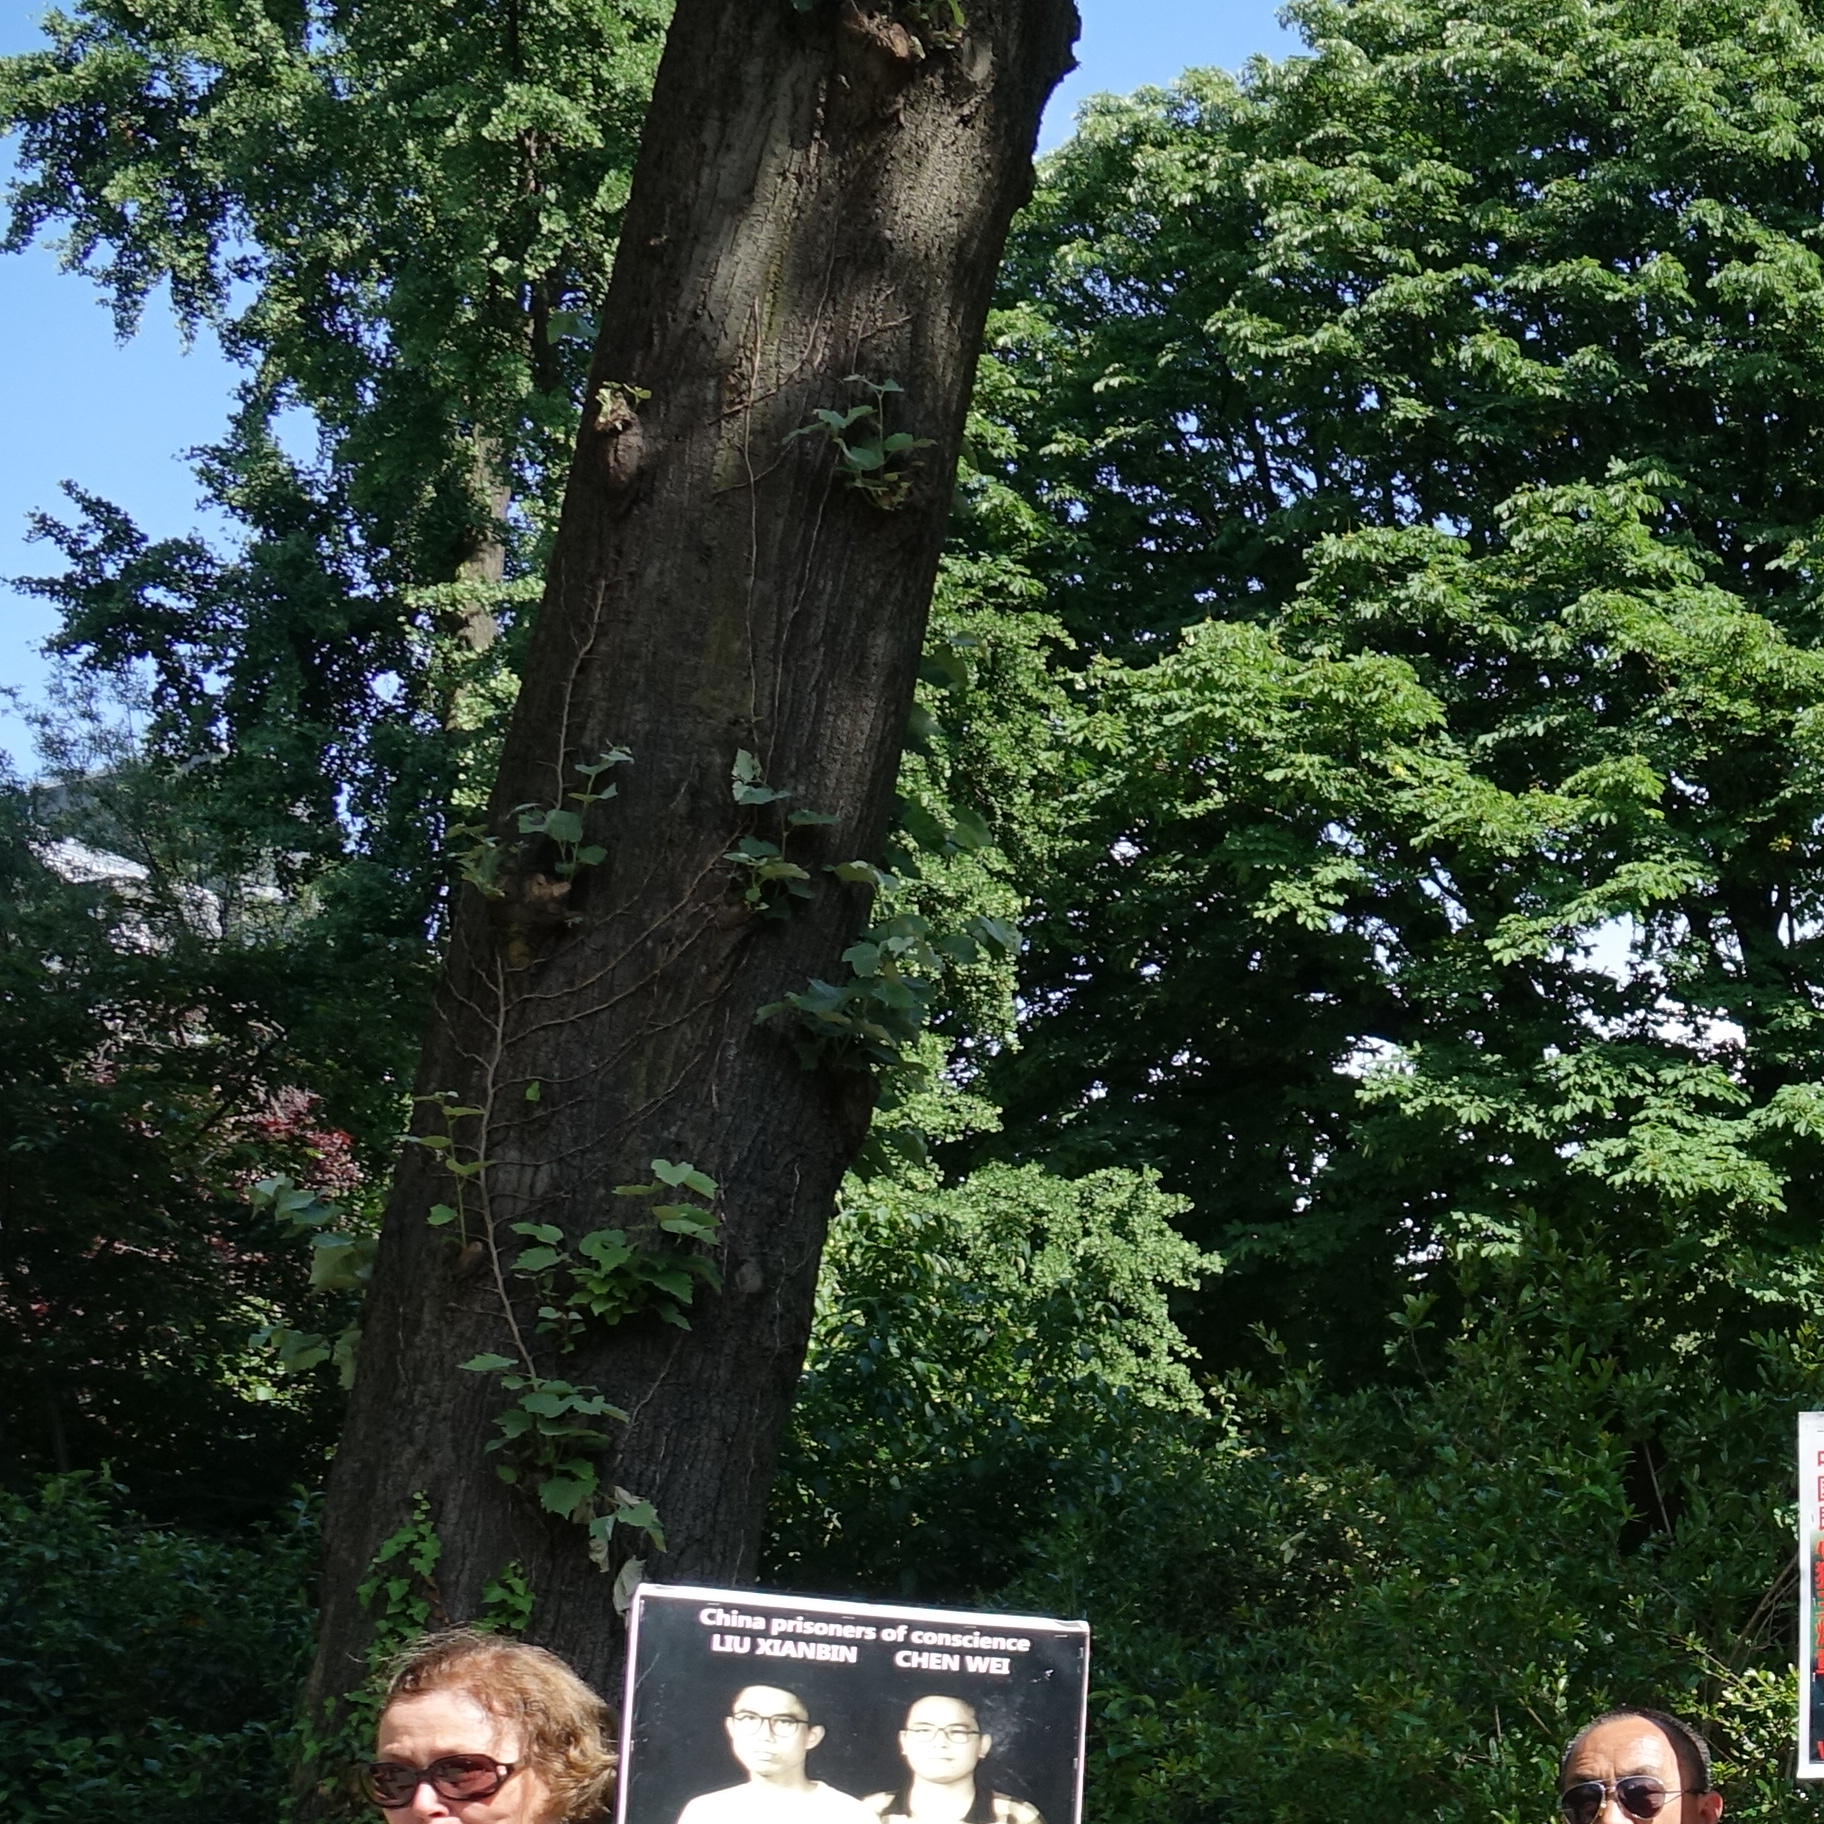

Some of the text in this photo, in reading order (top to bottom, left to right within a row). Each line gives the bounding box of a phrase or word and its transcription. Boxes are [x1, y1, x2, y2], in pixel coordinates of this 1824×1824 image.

[700, 1607, 1031, 1653] China prisoners of conscience
[712, 1634, 1011, 1675] LIU XIANBIN CHEN WEI
